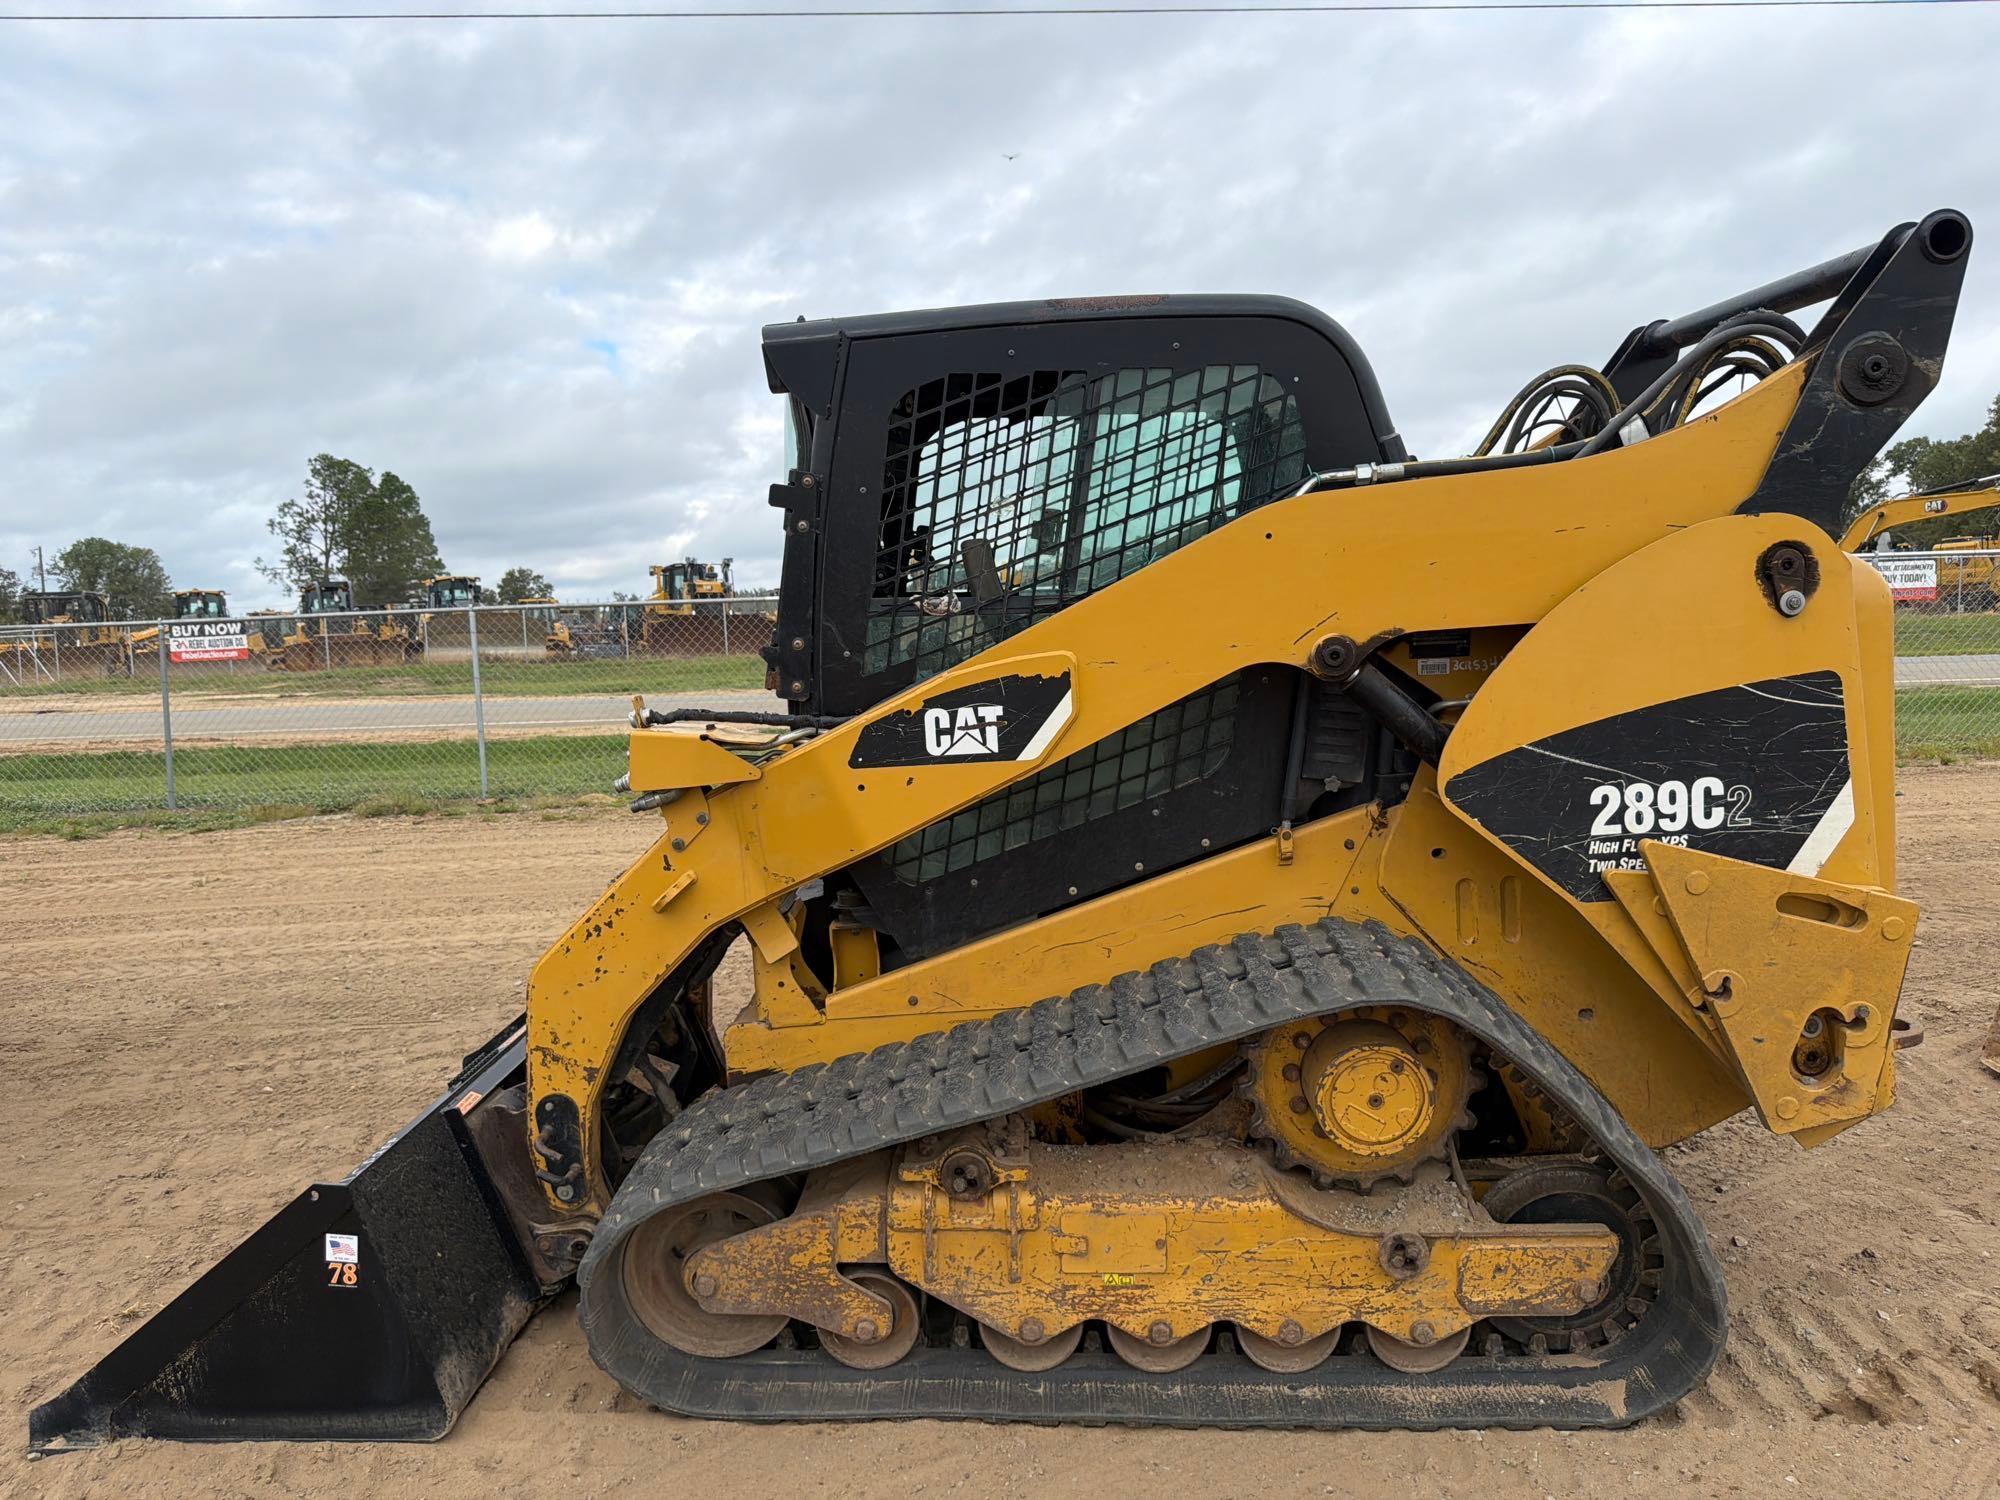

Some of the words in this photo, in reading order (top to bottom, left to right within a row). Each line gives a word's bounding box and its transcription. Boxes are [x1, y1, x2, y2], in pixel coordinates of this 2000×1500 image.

[1925, 500, 1942, 512] CAT
[1893, 563, 1934, 571] ATTACHMENTS
[1900, 573, 1927, 583] TODAY!
[172, 624, 200, 637] BUY
[204, 623, 241, 635] NOW
[188, 639, 206, 649] REBEL
[208, 638, 233, 648] AUCTION
[235, 637, 245, 647] CO.
[924, 705, 1003, 756] CAT
[328, 1262, 357, 1285] 78
